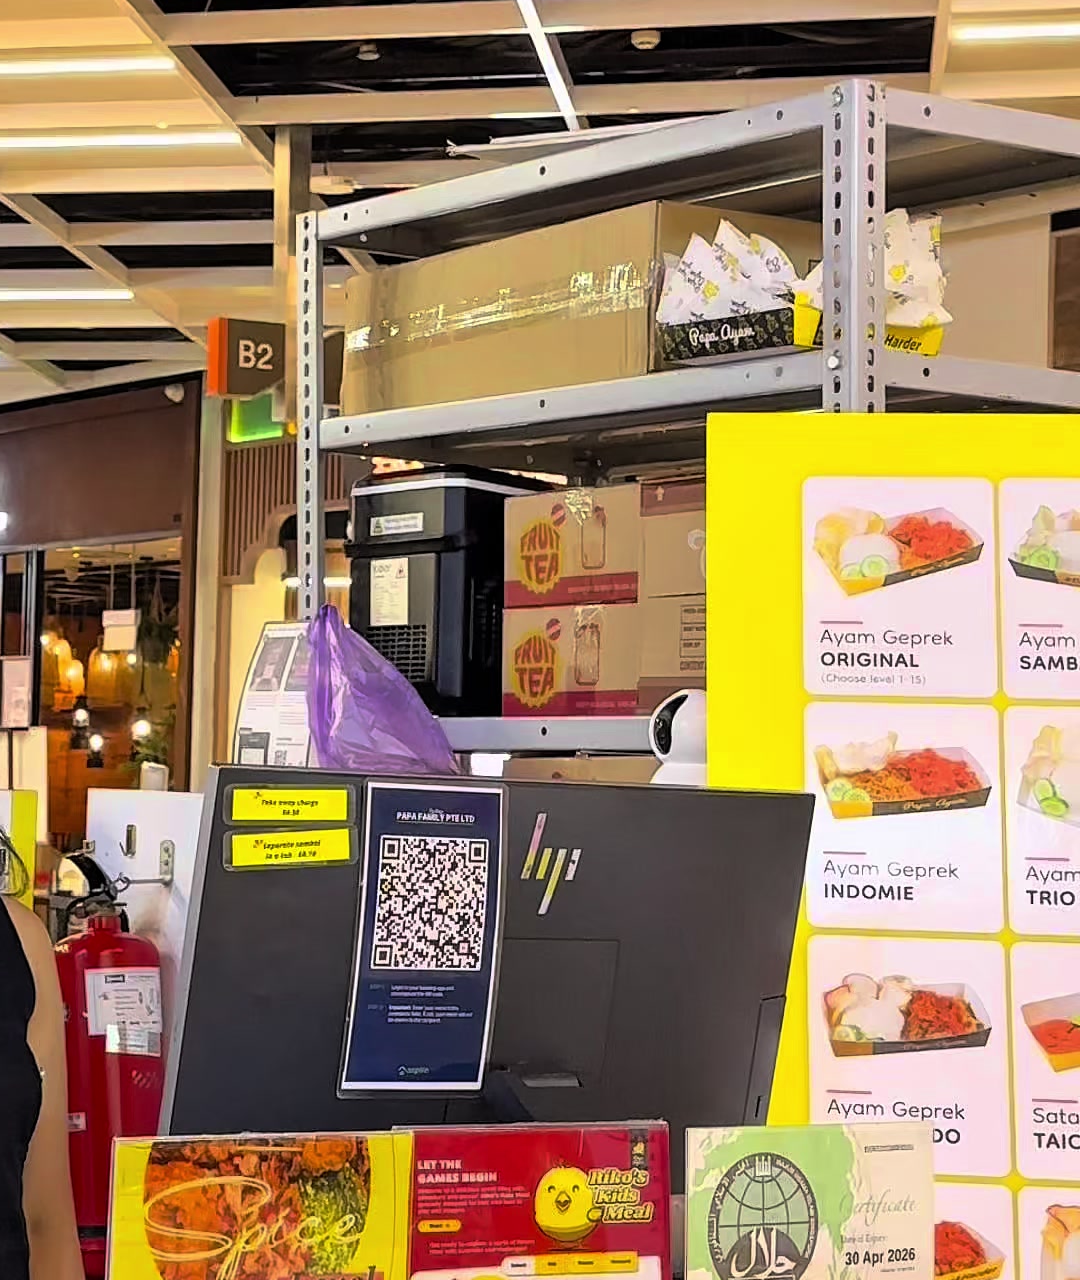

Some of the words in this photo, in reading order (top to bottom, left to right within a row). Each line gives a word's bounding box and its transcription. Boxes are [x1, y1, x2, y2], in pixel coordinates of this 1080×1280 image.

[689, 328, 718, 348] Papa
[721, 324, 755, 345] Ayam
[885, 334, 923, 351] Harder
[239, 340, 273, 370] B2
[520, 522, 561, 554] FRUIT
[520, 553, 561, 585] TEA
[820, 629, 875, 647] Ayam
[883, 630, 953, 648] Geprek
[1019, 632, 1075, 651] Ayam
[514, 635, 556, 665] FRUIT
[821, 652, 919, 667] ORIGINAL
[1019, 656, 1080, 670] SAMB
[514, 666, 556, 698] TEA
[821, 674, 866, 684] (Choose
[870, 674, 895, 684] level
[396, 811, 417, 820] PAPA
[446, 813, 459, 822] PTE
[461, 814, 475, 823] LTD
[824, 859, 879, 878] Ayam
[887, 862, 960, 880] Geprek
[1025, 866, 1080, 885] Ayam
[824, 884, 914, 900] INDOMIE
[1026, 890, 1076, 906] TRIO
[827, 1099, 884, 1119] Ayam
[892, 1101, 965, 1121] Geprek
[417, 1160, 437, 1169] LET
[439, 1160, 462, 1169] THE
[417, 1173, 459, 1184] GAMES
[461, 1172, 497, 1182] BEGIN
[588, 1168, 649, 1187] Riko's
[596, 1186, 638, 1204] Kids
[605, 1203, 653, 1221] Meal
[845, 1251, 859, 1266] 30
[863, 1250, 884, 1267] Apr
[887, 1248, 915, 1262] 2026
